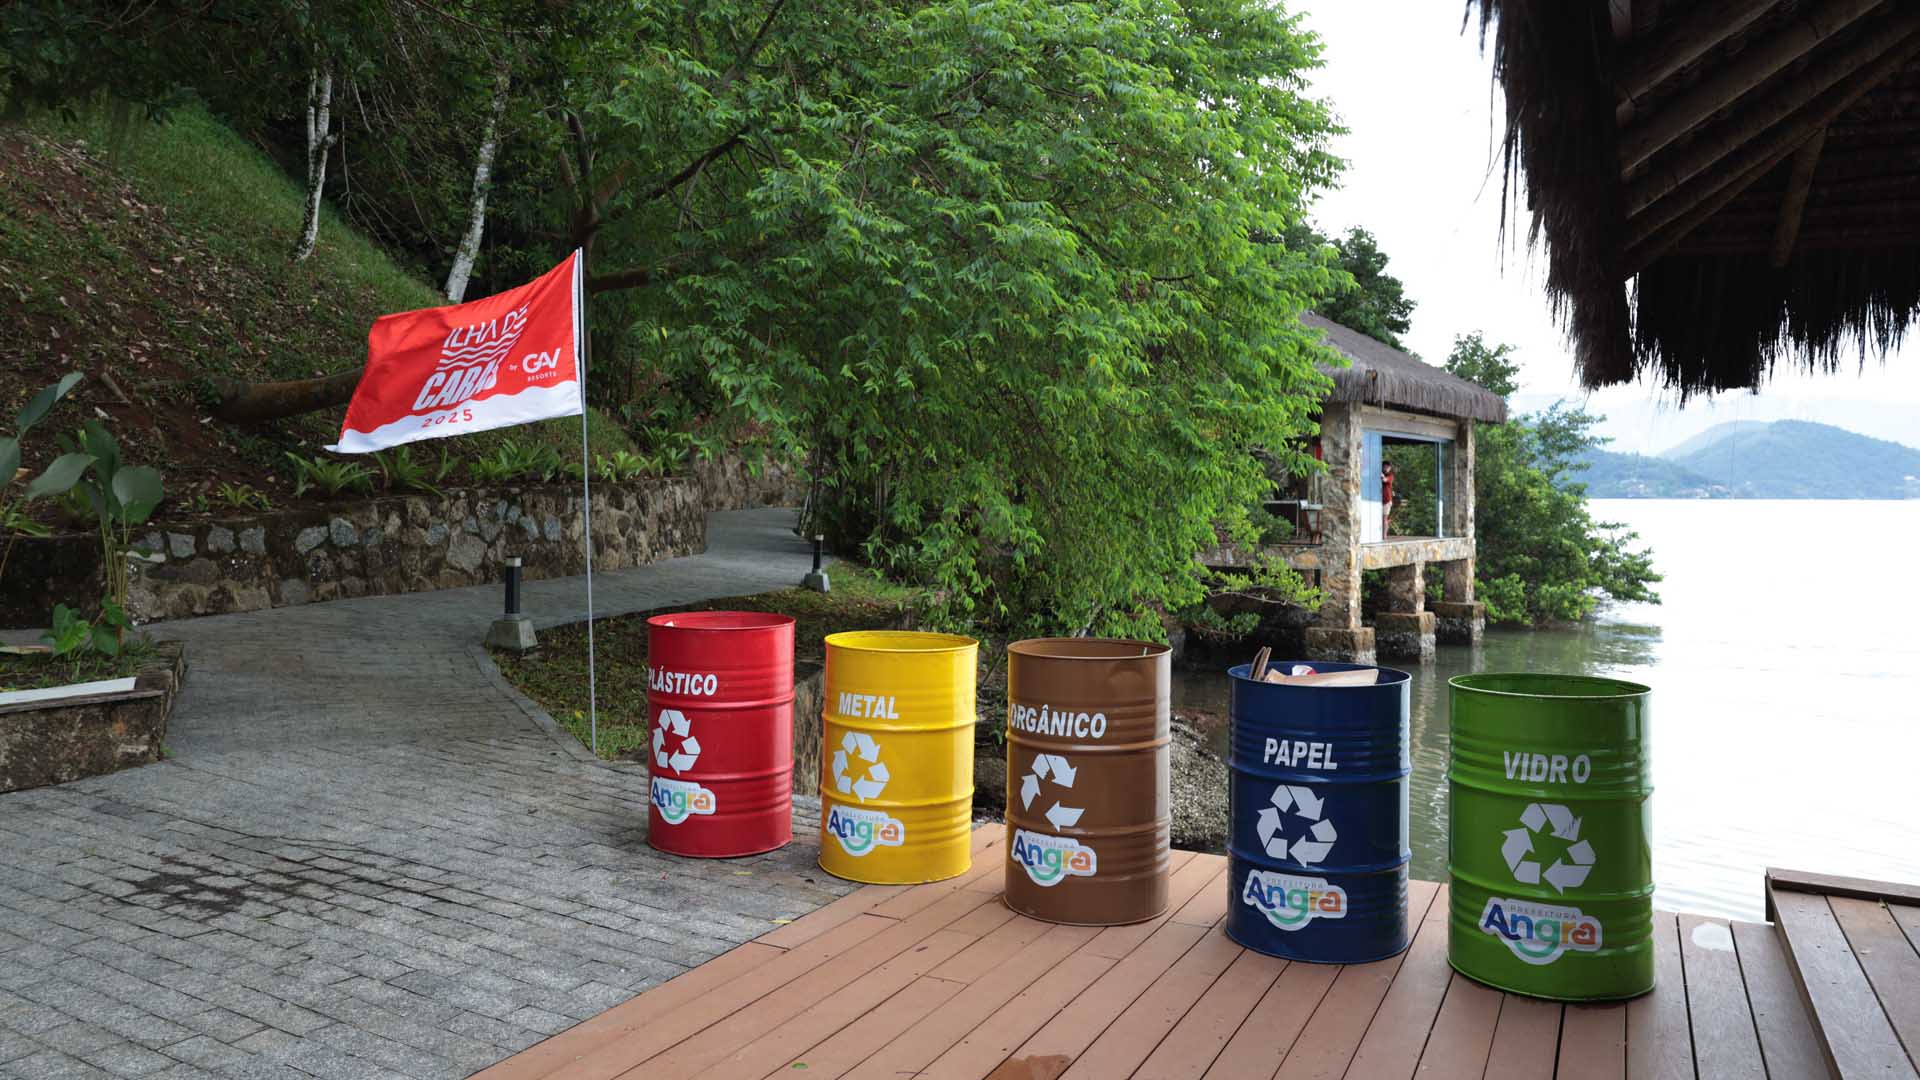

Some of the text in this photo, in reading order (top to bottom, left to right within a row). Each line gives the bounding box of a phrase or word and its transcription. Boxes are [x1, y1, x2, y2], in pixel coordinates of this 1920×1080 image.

[444, 319, 497, 348] ILHA
[522, 347, 561, 374] GAV
[421, 409, 473, 428] 2025
[838, 692, 899, 720] METAL
[1010, 703, 1107, 739] ORGÂNICO
[1263, 737, 1338, 770] PAPEL
[1503, 751, 1592, 784] VIDRO
[651, 780, 711, 820] Angra
[829, 809, 900, 852] Angra
[1013, 834, 1092, 881] Angra
[1246, 875, 1341, 926] Angra
[1484, 903, 1597, 958] Angra
